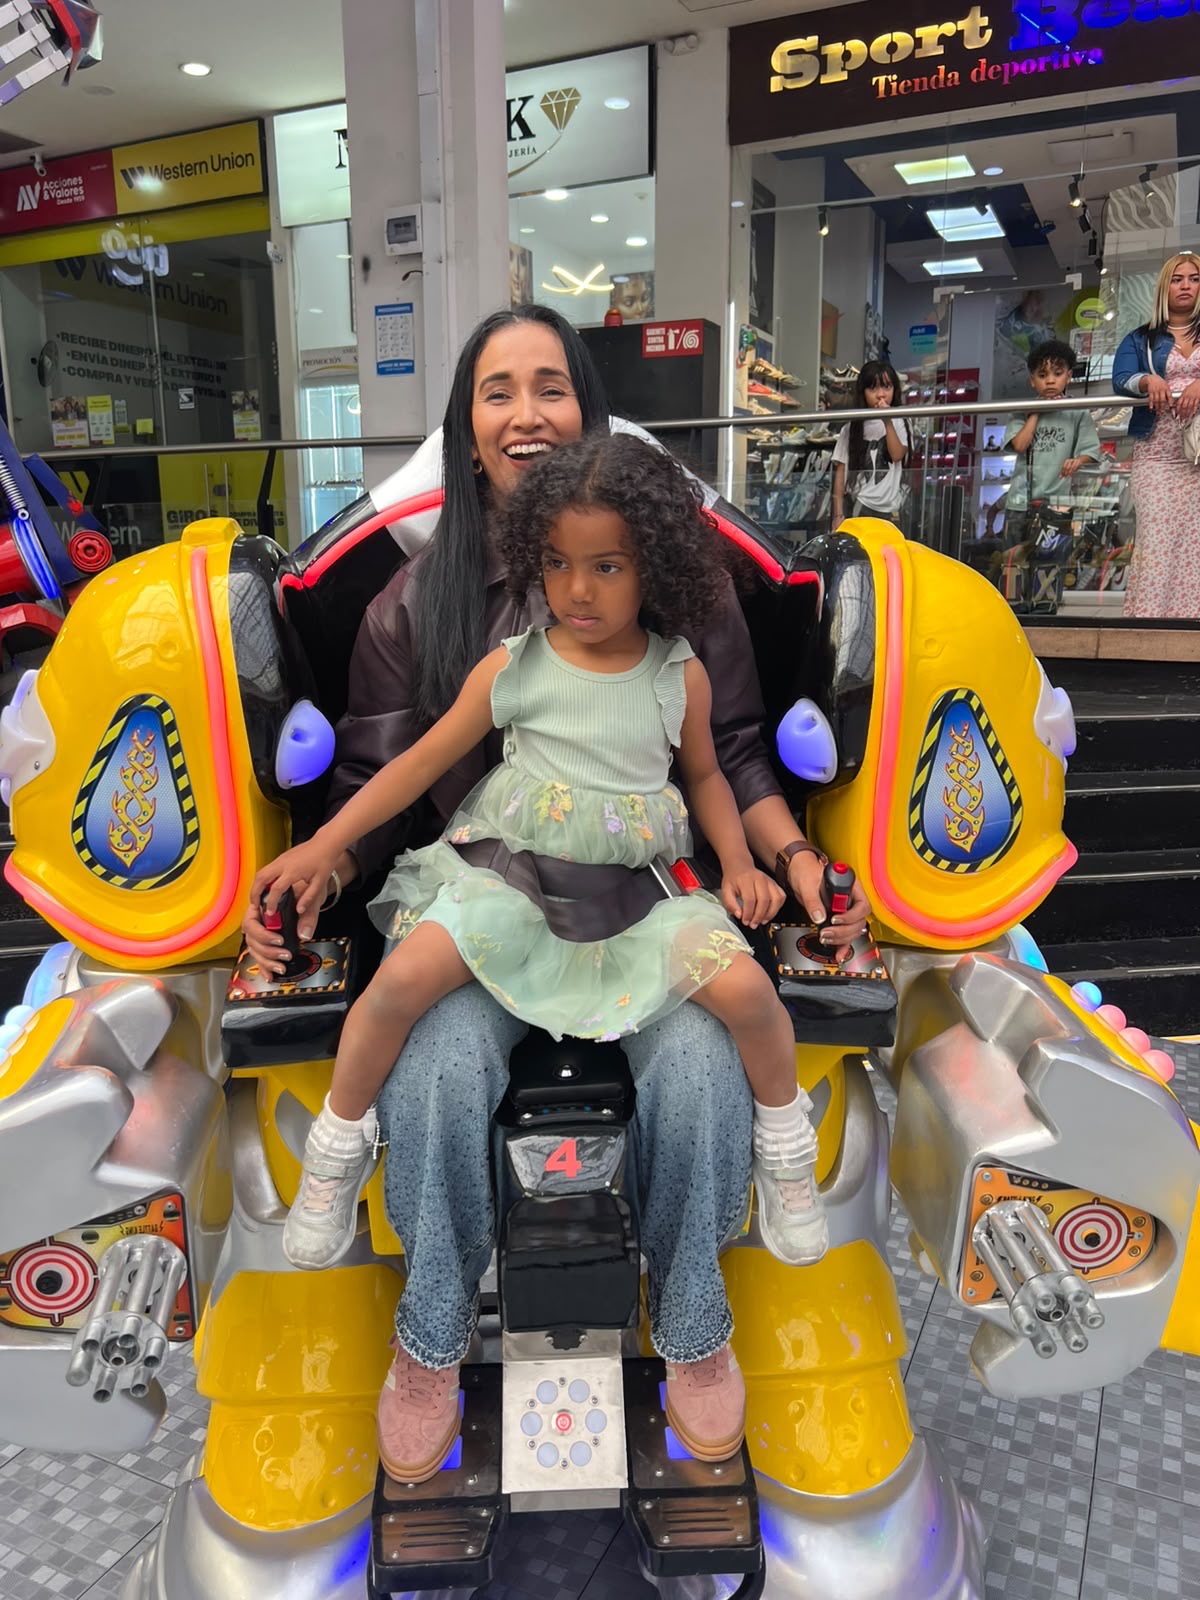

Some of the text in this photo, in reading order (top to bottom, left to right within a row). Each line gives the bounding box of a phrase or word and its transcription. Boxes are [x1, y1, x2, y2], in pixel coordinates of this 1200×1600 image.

[769, 5, 993, 93] Sport
[871, 44, 1105, 99] Tienda deportiva
[149, 152, 255, 181] Western Union
[42, 175, 84, 190] Acciones
[42, 185, 84, 201] &Valores
[176, 281, 229, 315] Union
[67, 366, 123, 384] COMPRA
[124, 375, 132, 385] Y
[544, 1138, 582, 1178] 4
